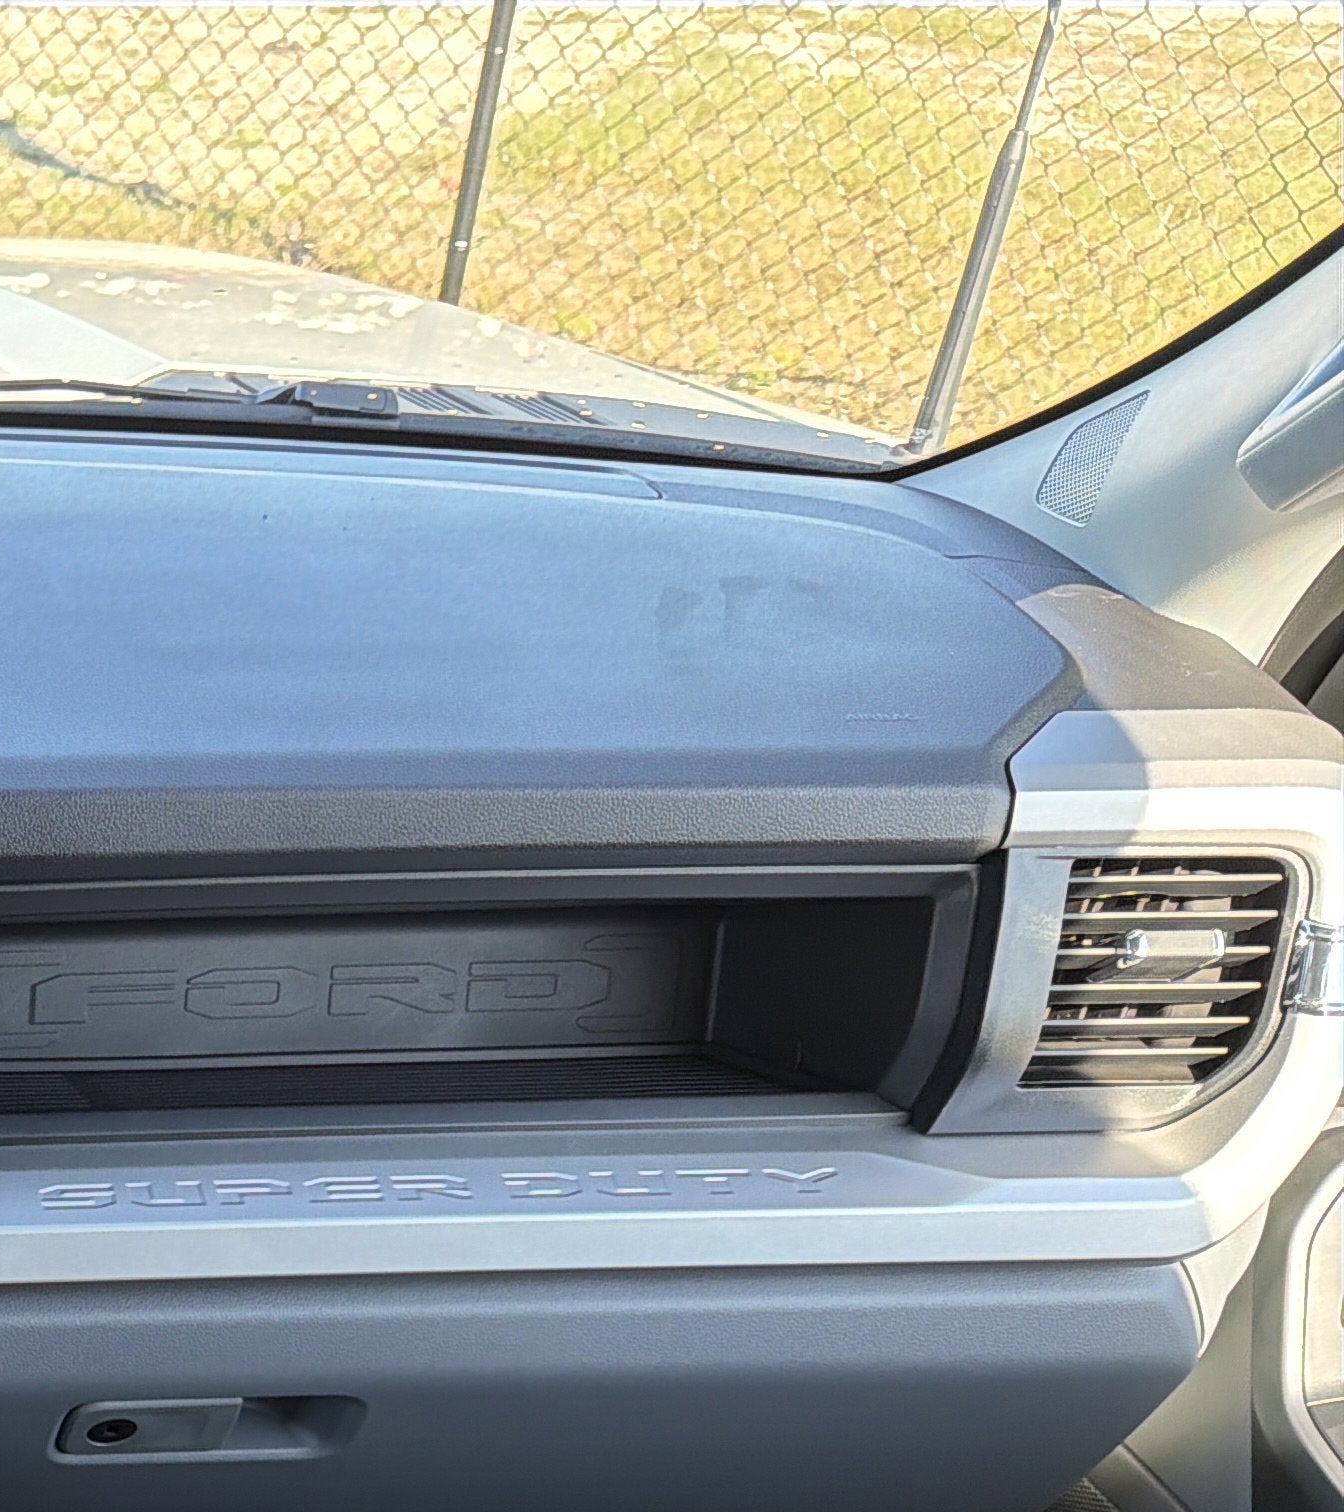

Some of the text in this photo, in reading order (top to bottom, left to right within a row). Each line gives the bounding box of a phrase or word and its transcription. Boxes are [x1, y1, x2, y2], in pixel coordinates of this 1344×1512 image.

[29, 959, 612, 1024] FORD
[37, 1167, 838, 1210] SUPER DUTY
